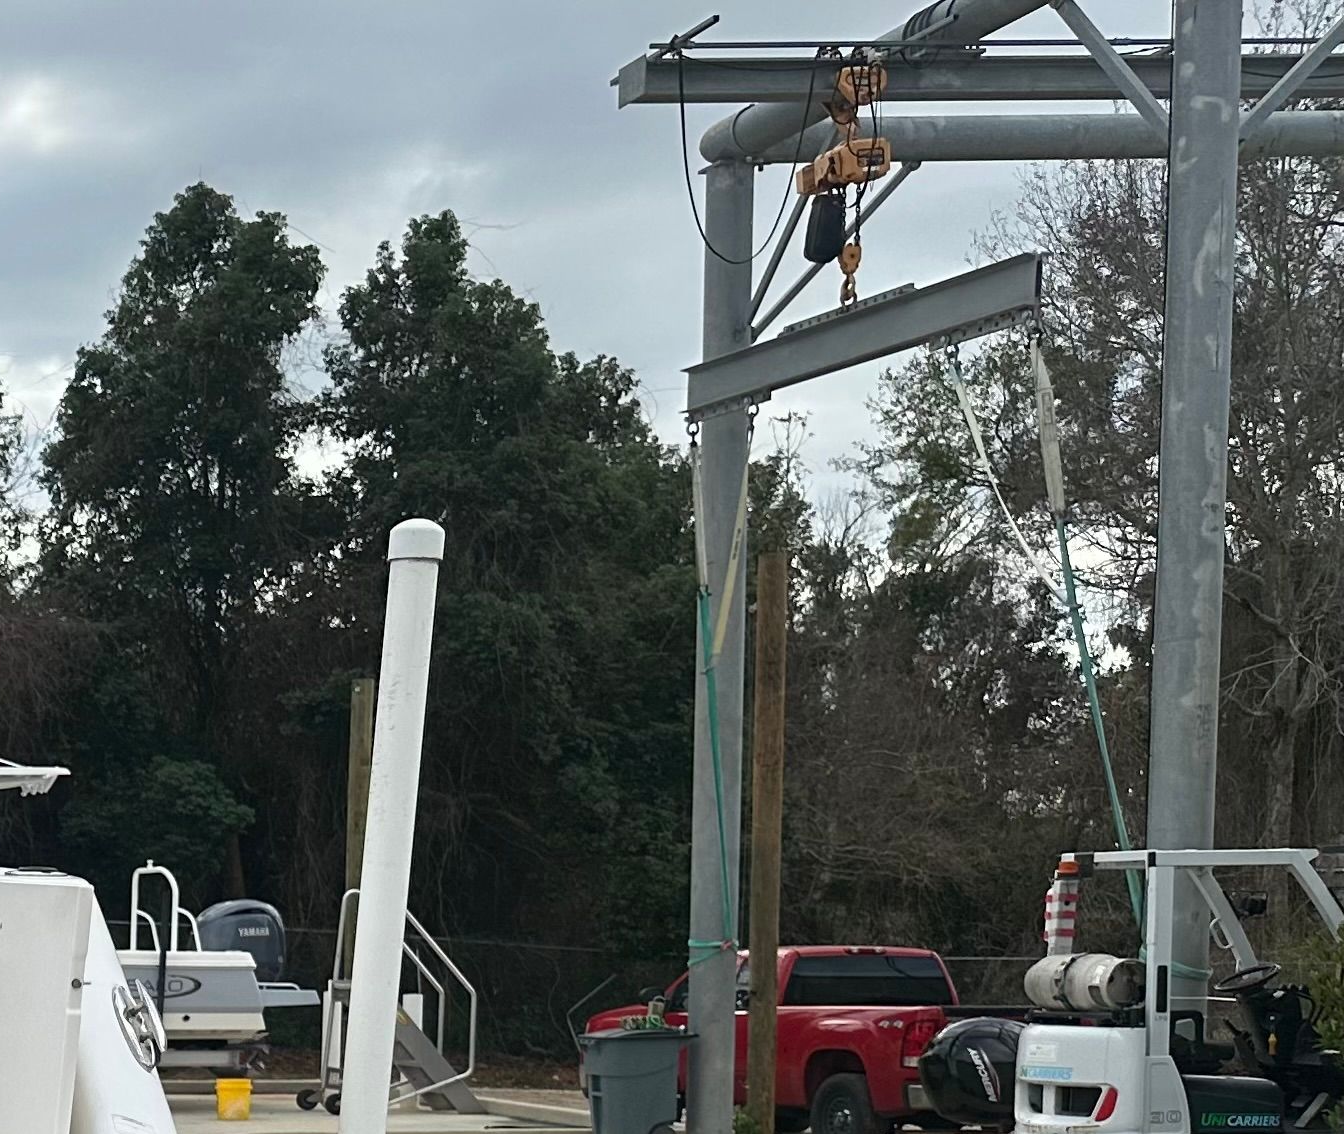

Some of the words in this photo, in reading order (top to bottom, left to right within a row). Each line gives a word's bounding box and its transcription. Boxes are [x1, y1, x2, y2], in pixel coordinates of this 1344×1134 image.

[237, 927, 270, 938] YAMAHA
[966, 1047, 999, 1102] MERCURY
[1149, 1110, 1182, 1125] 30
[1201, 1113, 1281, 1127] UNICARRIERS
